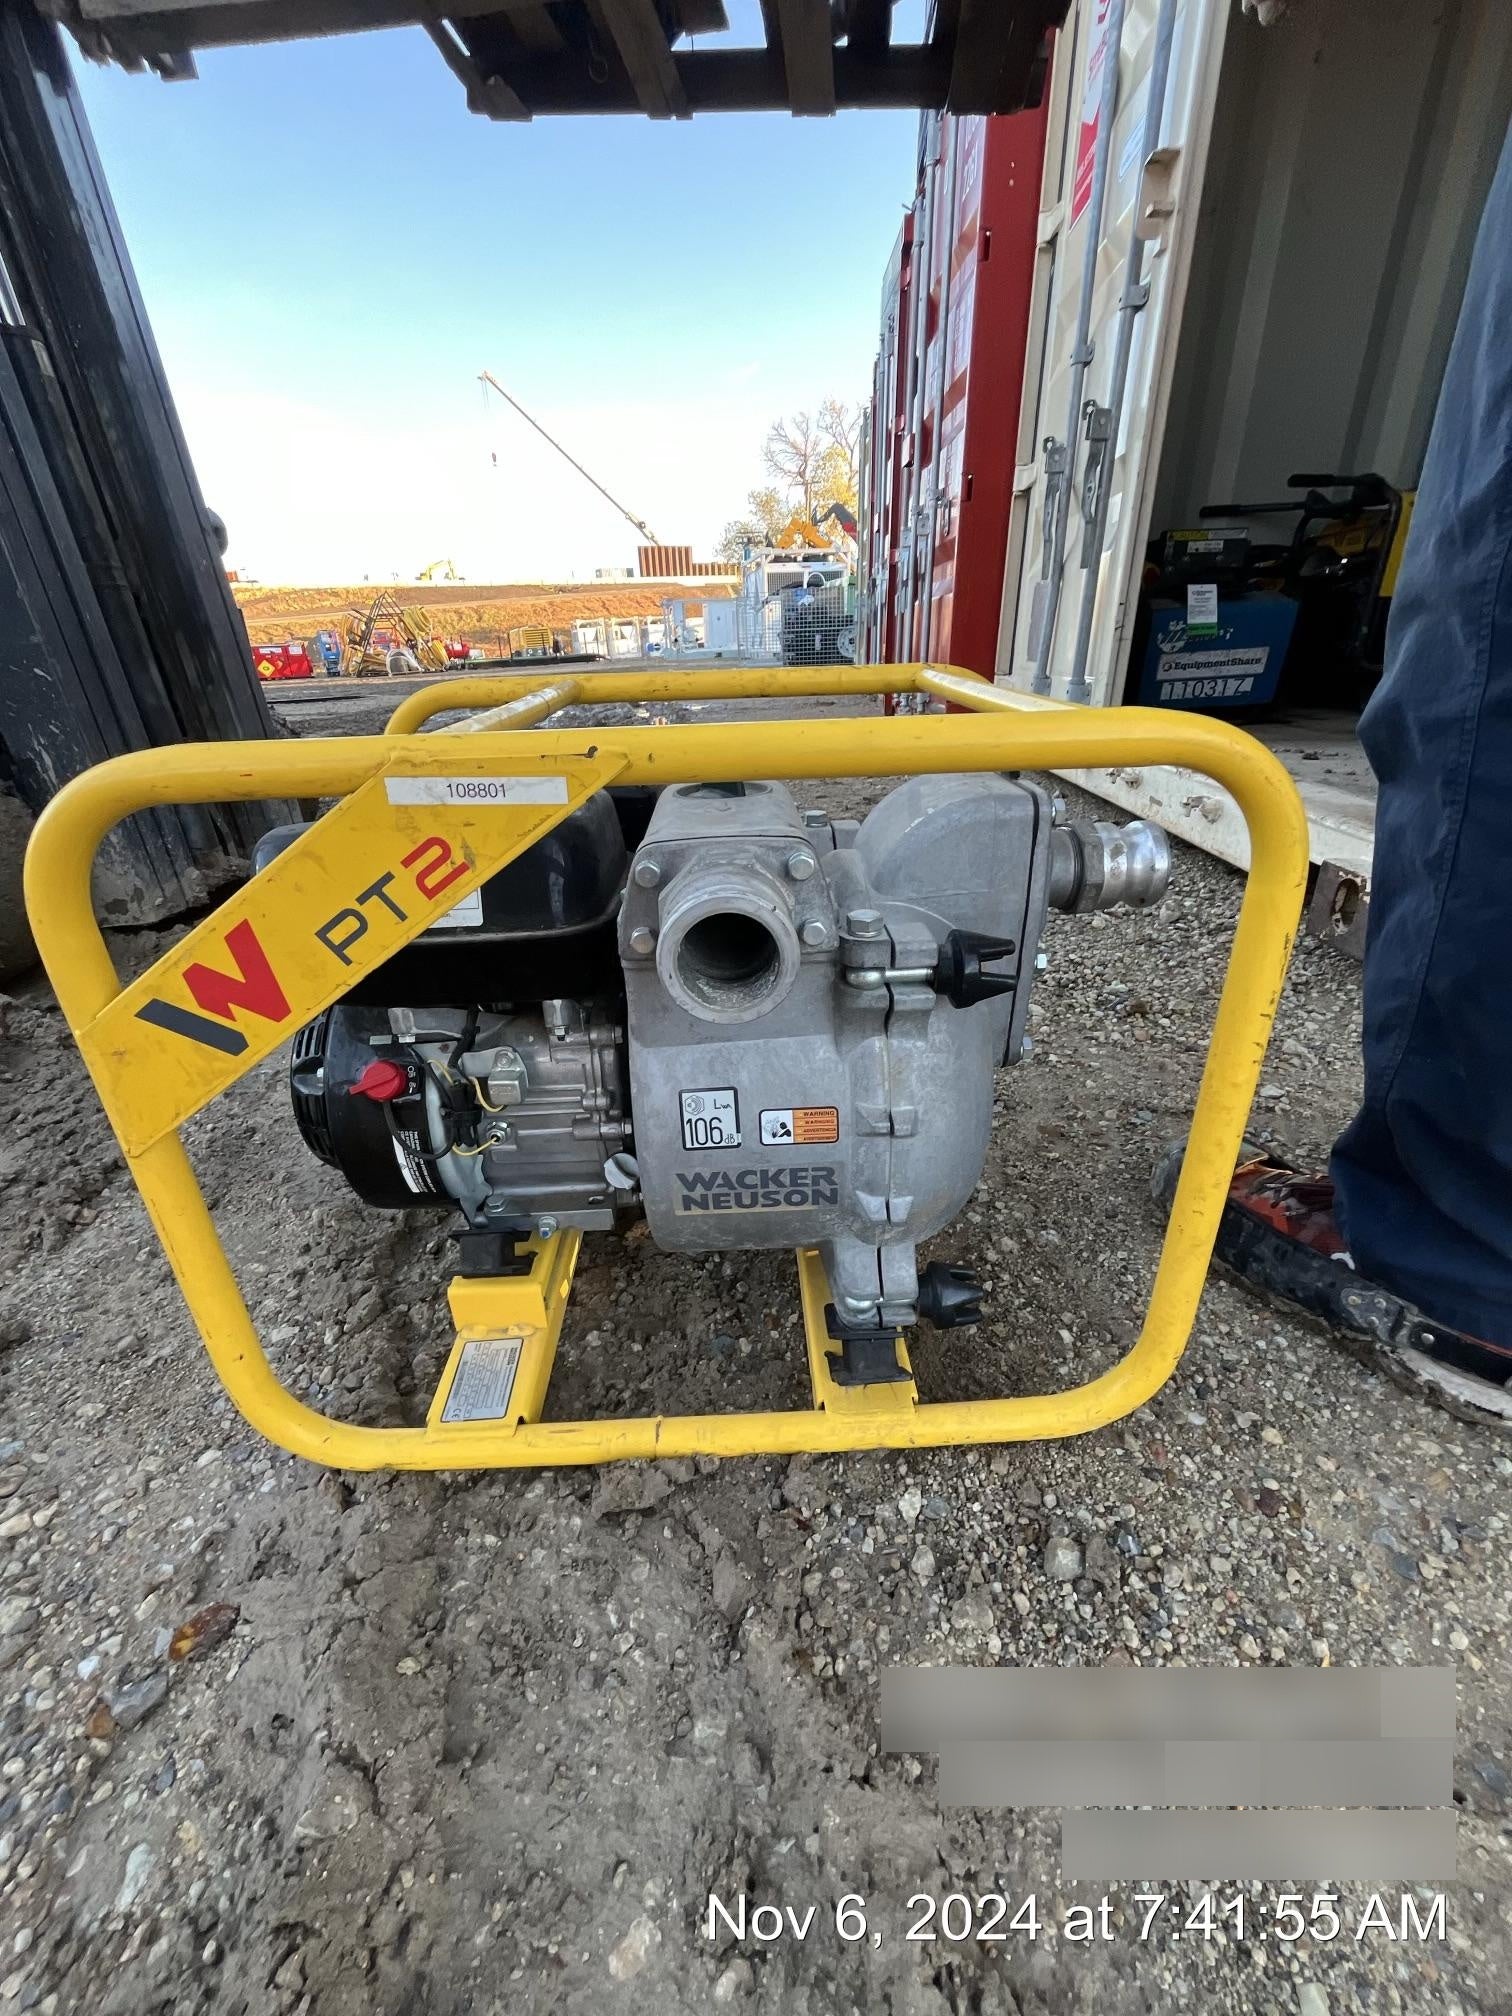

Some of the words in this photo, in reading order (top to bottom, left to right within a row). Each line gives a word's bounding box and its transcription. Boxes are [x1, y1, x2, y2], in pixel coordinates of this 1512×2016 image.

[1173, 656, 1262, 671] EquipmentShare
[1167, 678, 1246, 700] 110317
[445, 782, 508, 799] 108801
[314, 836, 471, 967] PT2
[685, 1116, 724, 1147] 106
[724, 1133, 736, 1145] dB
[675, 1166, 839, 1192] WACKER
[681, 1188, 839, 1212] NEUSON
